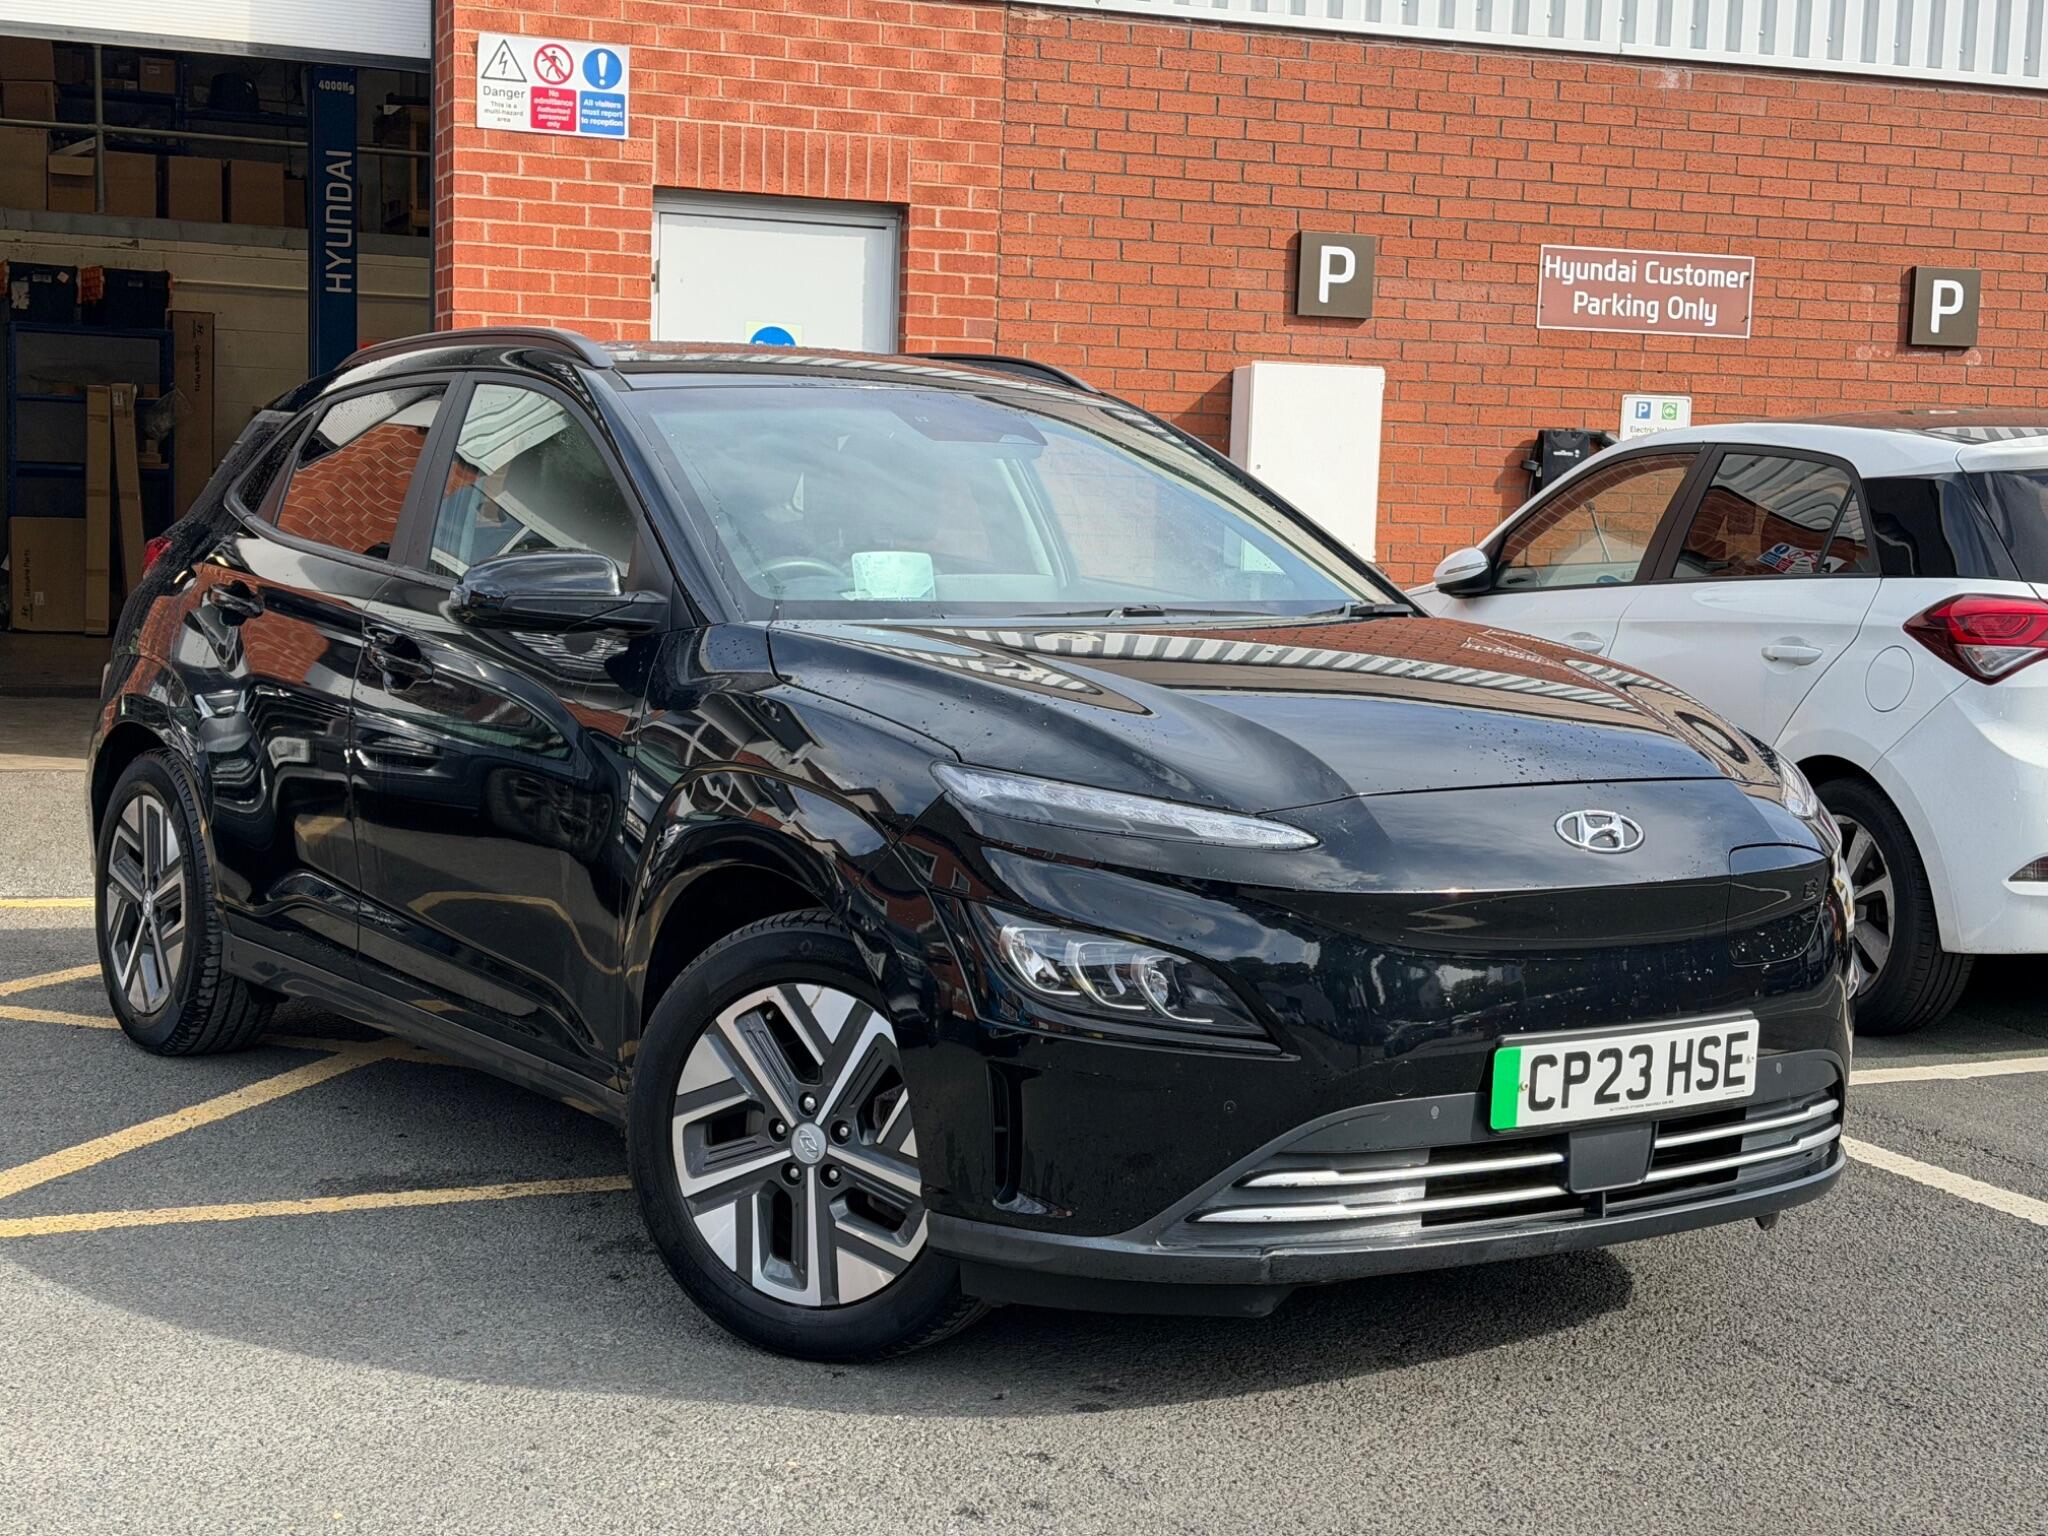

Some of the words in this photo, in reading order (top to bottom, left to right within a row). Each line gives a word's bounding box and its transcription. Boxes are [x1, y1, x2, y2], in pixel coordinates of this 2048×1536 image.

[483, 85, 525, 100] Danger
[548, 89, 560, 98] No
[583, 98, 594, 106] All
[595, 100, 621, 108] visitors
[581, 108, 600, 116] must
[601, 110, 623, 118] report
[590, 118, 623, 127] reception
[325, 150, 352, 293] HYUNDAI
[1319, 245, 1356, 304] P
[1545, 255, 1637, 285] Hyundai
[1645, 261, 1750, 289] Customer
[1573, 291, 1660, 324] Parking
[1667, 296, 1718, 327] Only
[1930, 279, 1965, 334] P
[1637, 402, 1649, 418] P
[1528, 1044, 1654, 1112] CP23
[1666, 1031, 1750, 1097] HSE
